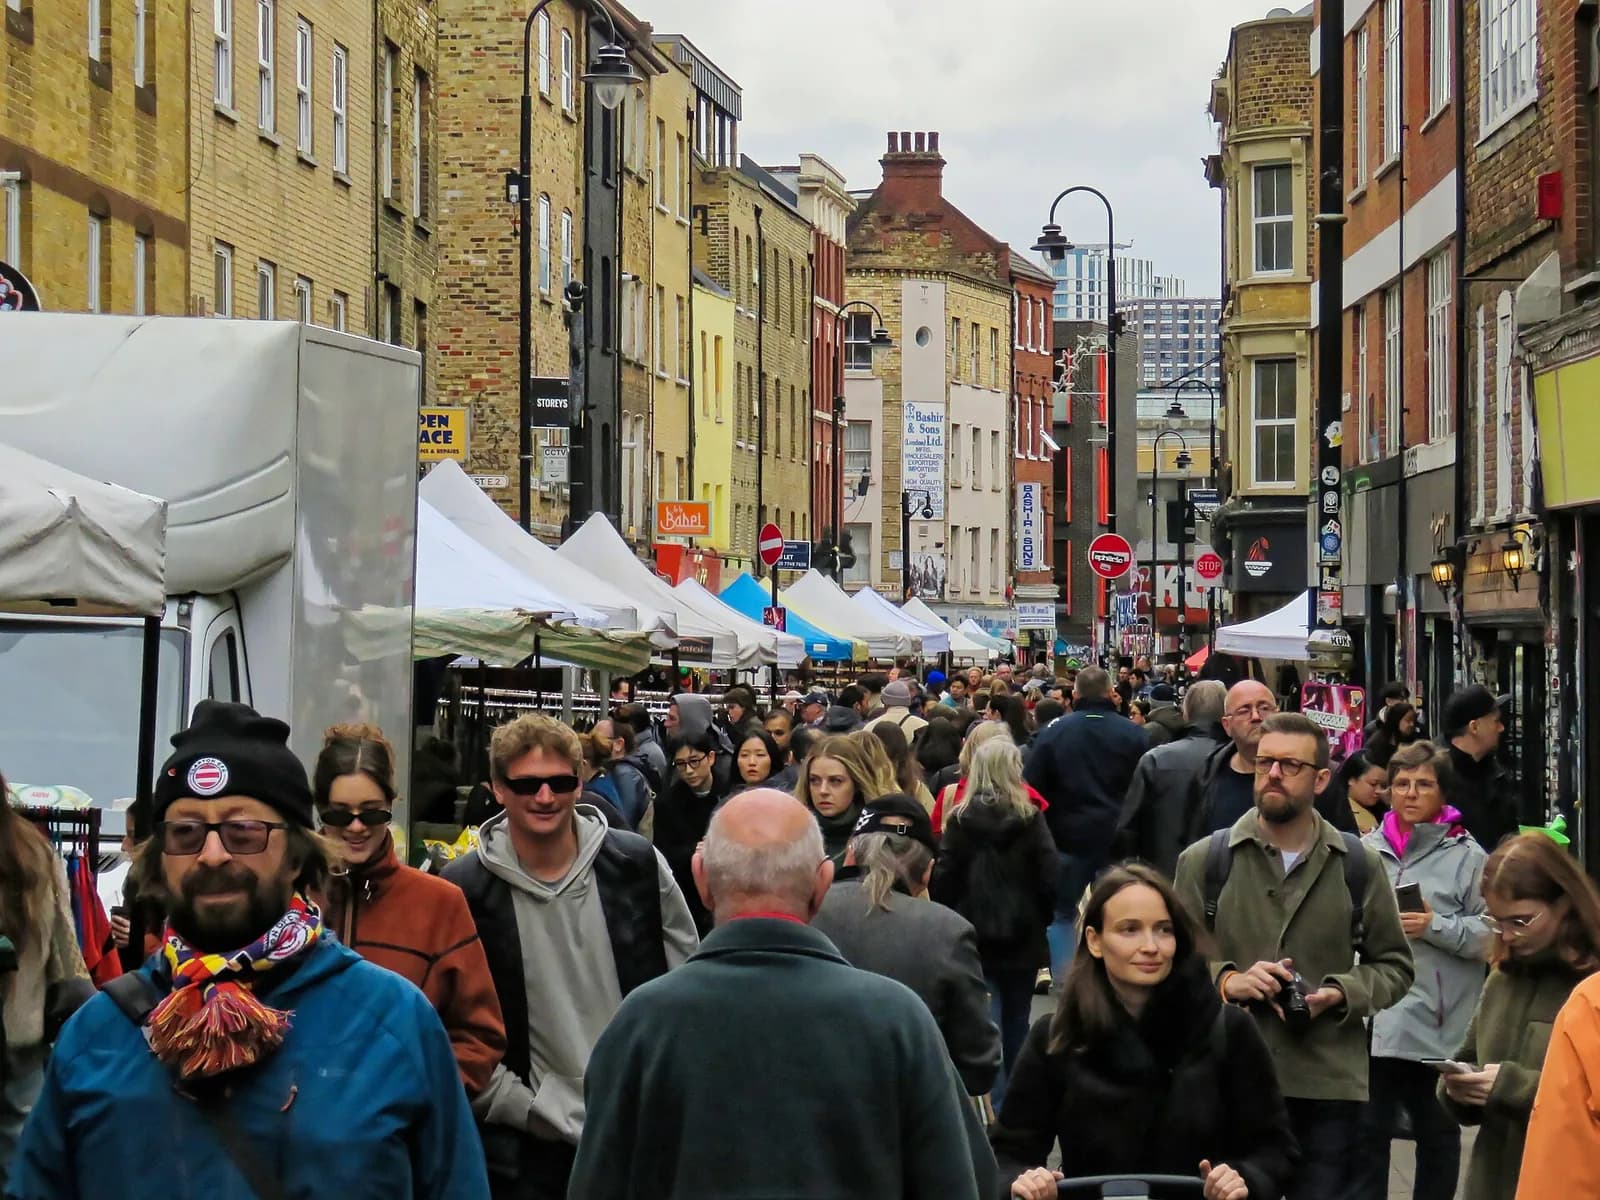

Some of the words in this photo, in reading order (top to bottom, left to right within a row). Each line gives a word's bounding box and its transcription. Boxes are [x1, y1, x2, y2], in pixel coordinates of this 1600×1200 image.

[537, 398, 568, 408] STOREYS
[915, 411, 944, 422] Bashir
[907, 422, 914, 433] &
[919, 423, 940, 434] Sons
[544, 448, 566, 456] CCTV
[1023, 485, 1033, 527] BASHIR
[660, 505, 706, 530] Babel
[1022, 537, 1033, 566] SONS
[1198, 561, 1221, 571] STOP
